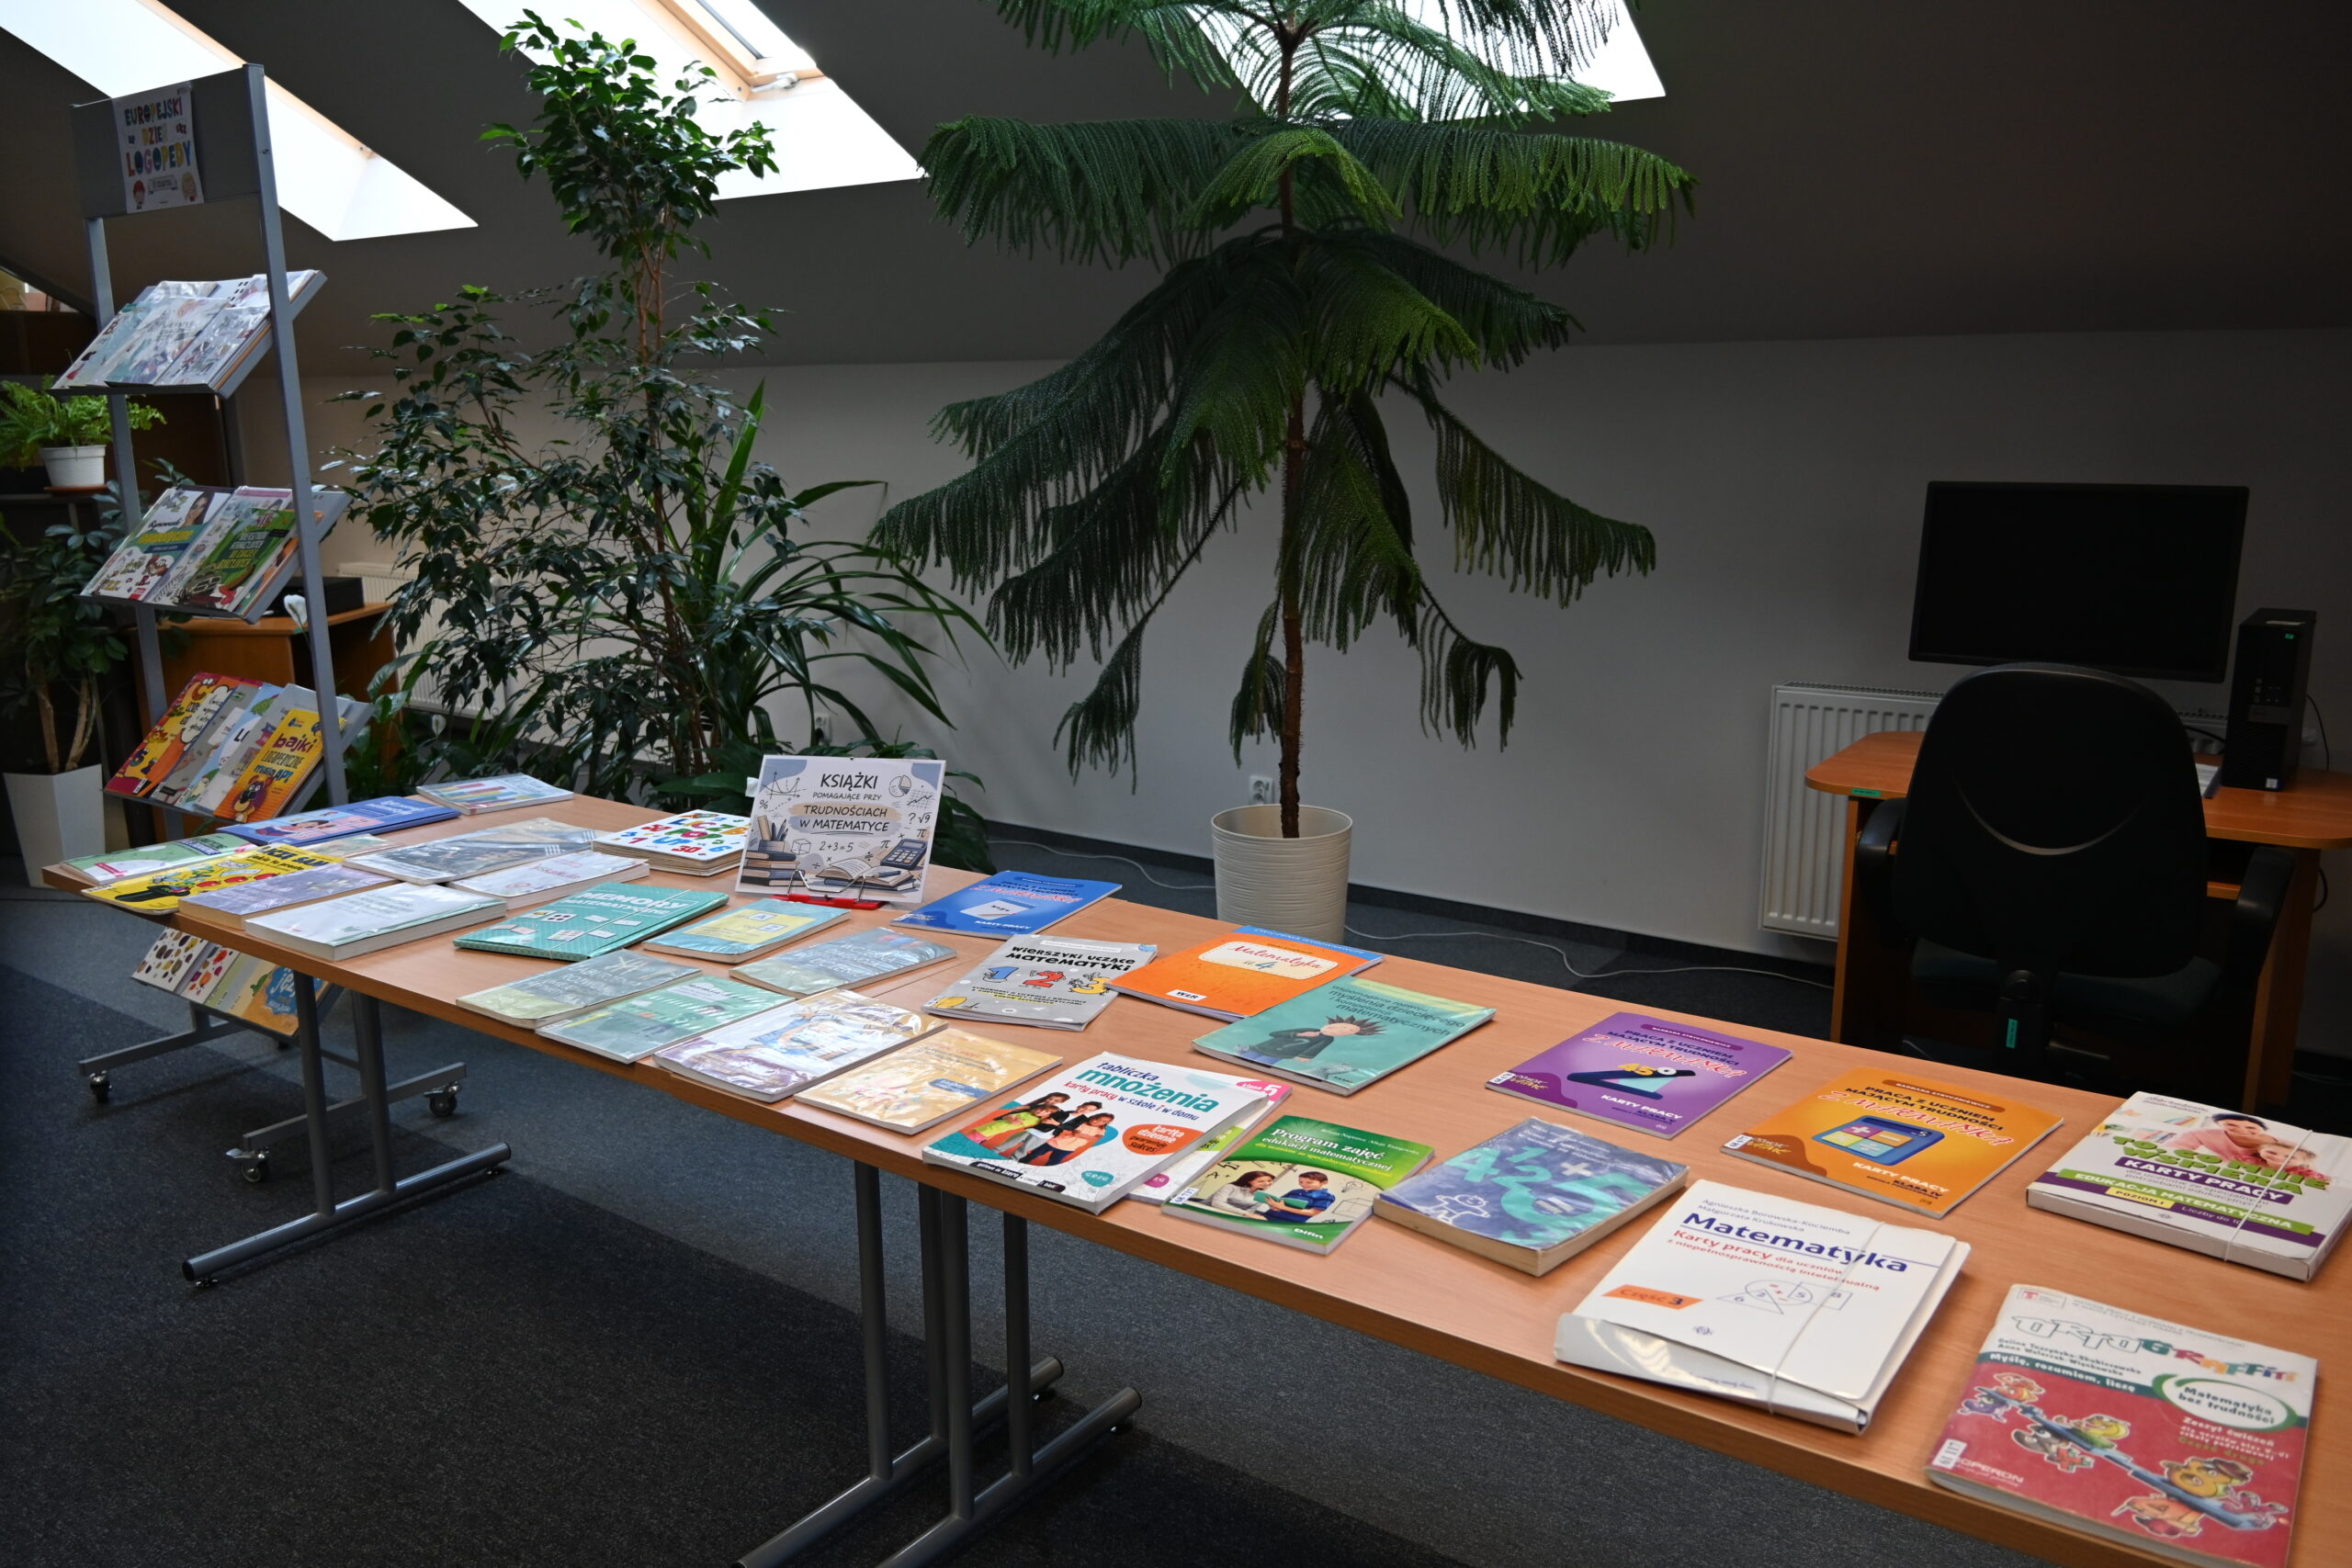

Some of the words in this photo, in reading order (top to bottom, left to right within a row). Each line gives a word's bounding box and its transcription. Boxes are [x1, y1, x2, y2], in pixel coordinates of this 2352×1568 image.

[124, 96, 183, 126] EUROPEJSKI
[126, 141, 191, 176] LOGOPEDY
[273, 733, 318, 753] bajki
[812, 792, 860, 801] POMAGAJĄCE
[820, 772, 878, 792] KSIĄŻKI
[799, 819, 812, 828] W
[814, 819, 890, 831] MATEMATYCE
[803, 805, 888, 818] TRUDNOŚCIACH
[667, 818, 749, 835] LICZB
[575, 892, 690, 909] MEMORY
[1227, 945, 1322, 969] Matematyka
[1254, 961, 1278, 970] 4
[1329, 989, 1384, 1009] myślenia
[1387, 1003, 1465, 1028] dziecięcego
[1332, 985, 1393, 1003] Wspomaganie
[1394, 1001, 1428, 1011] rozwoju
[1336, 998, 1392, 1016] kompetencji
[1336, 1003, 1451, 1036] matematycznych
[1582, 1033, 1610, 1045] Z
[1607, 1032, 1666, 1047] MAJĄCYM
[1668, 1044, 1739, 1066] TRUDNOŚCI
[1624, 1030, 1666, 1043] PRACA
[1678, 1041, 1735, 1058] UCZNIEM
[1096, 1061, 1159, 1081] tabliczka
[1063, 1080, 1090, 1096] karty
[1090, 1088, 1118, 1101] pracy
[1128, 1097, 1157, 1110] szkole
[1170, 1109, 1200, 1122] domu
[1075, 1068, 1219, 1112] mnożenia
[1263, 1084, 1283, 1097] 5
[1817, 1090, 1850, 1101] Z
[1895, 1082, 1930, 1093] BARBARA
[1600, 1094, 1640, 1108] KARTY
[1641, 1105, 1684, 1120] PRACY
[1845, 1088, 1916, 1109] MAJĄCYM
[1920, 1105, 2004, 1131] TRUDNOŚCI
[1865, 1086, 1913, 1100] PRACA
[1929, 1100, 1996, 1122] UCZNIEM
[1137, 1128, 1177, 1144] dziennie
[1152, 1125, 1185, 1138] kartka
[1272, 1128, 1343, 1149] Program
[1341, 1145, 1385, 1160] zajęć
[1261, 1137, 1308, 1151] edukacji
[1309, 1147, 1393, 1171] matematycznej
[2174, 1147, 2223, 1164] CO
[2229, 1157, 2331, 1190] MNIE
[1853, 1161, 1898, 1179] KARTY
[1900, 1174, 1951, 1193] PRACY
[1893, 1179, 1929, 1192] KLASA
[2122, 1147, 2303, 1195] WSPIERA
[2124, 1158, 2203, 1184] KARTY
[2205, 1177, 2287, 1201] PRACY
[2125, 1174, 2187, 1191] potrzebami
[2143, 1172, 2188, 1187] uczniów
[2075, 1172, 2158, 1195] EDUKACJA
[2160, 1190, 2292, 1229] MATEMATYCZNA
[2115, 1190, 2157, 1204] POZIOM
[2181, 1205, 2215, 1219] Liczby
[2216, 1214, 2231, 1223] do
[1697, 1204, 1750, 1222] Małgorzata
[1752, 1217, 1805, 1233] Krukowska
[1702, 1199, 1749, 1213] Agnieszka
[1751, 1211, 1850, 1235] Borowska-Kociemba
[1294, 1227, 1323, 1239] Difin
[1682, 1212, 1908, 1272] Matematyka
[1673, 1229, 1721, 1249] Karty
[1724, 1243, 1772, 1261] pracy
[1775, 1255, 1794, 1264] dla
[1796, 1259, 1843, 1275] uczniów
[1675, 1239, 1796, 1274] niepełnosprawnością
[1620, 1288, 1664, 1304] Część
[1668, 1297, 1684, 1306] 3
[1990, 1353, 2030, 1367] Myślę,
[2034, 1361, 2101, 1385] rozumiem,
[2106, 1379, 2136, 1393] liczę
[2178, 1393, 2202, 1404] bez
[2208, 1400, 2275, 1424] trudności
[2185, 1386, 2273, 1416] Matematyka
[2182, 1416, 2223, 1433] Zeszyt
[2226, 1428, 2275, 1447] ćwiczeń
